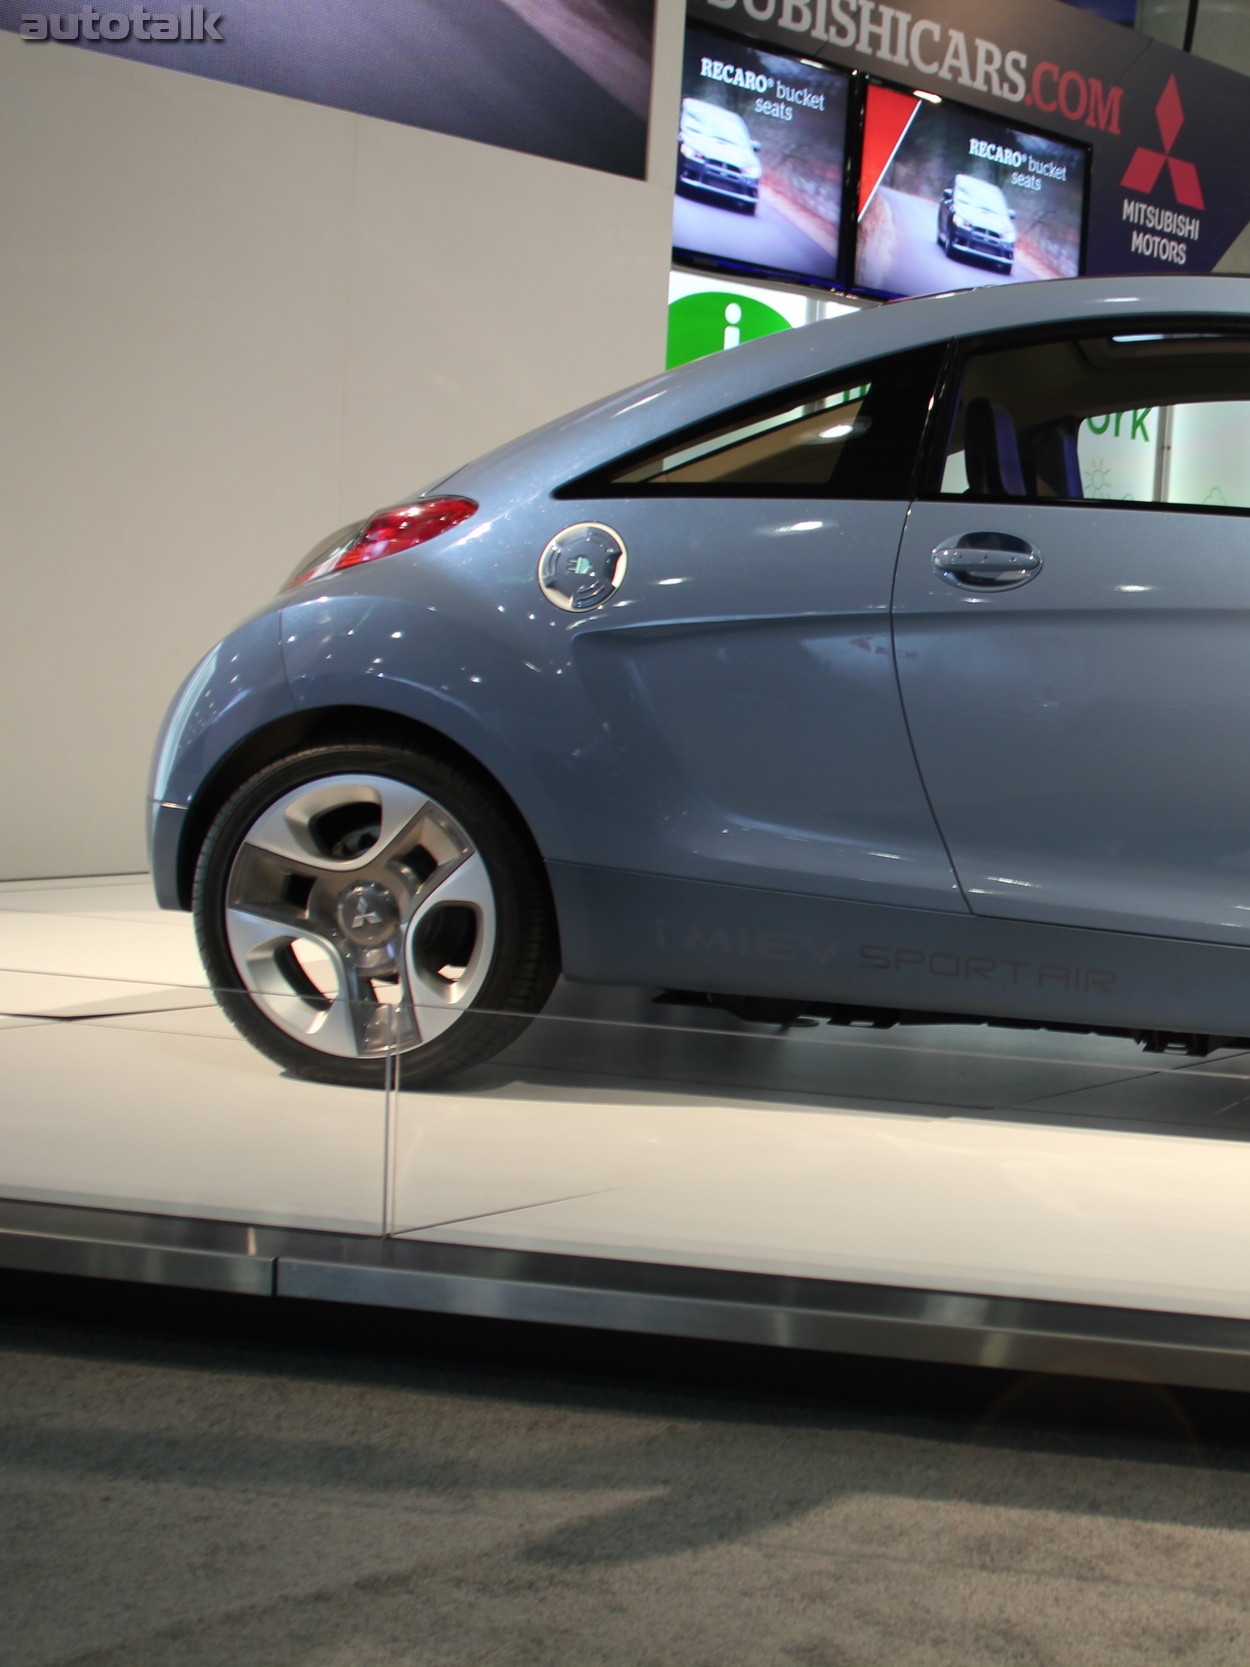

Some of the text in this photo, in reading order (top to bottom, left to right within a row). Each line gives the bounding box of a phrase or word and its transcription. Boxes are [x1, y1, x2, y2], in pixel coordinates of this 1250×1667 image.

[706, 0, 1121, 135] BISHICARS.COM
[755, 97, 793, 121] seats
[776, 80, 825, 111] bucket
[1010, 171, 1042, 192] seats
[1028, 155, 1067, 182] bucket
[1122, 198, 1200, 241] MITSUBISHI
[1131, 230, 1187, 265] MOTORS
[858, 943, 1030, 985] SPORT
[1036, 962, 1118, 995] AIR
